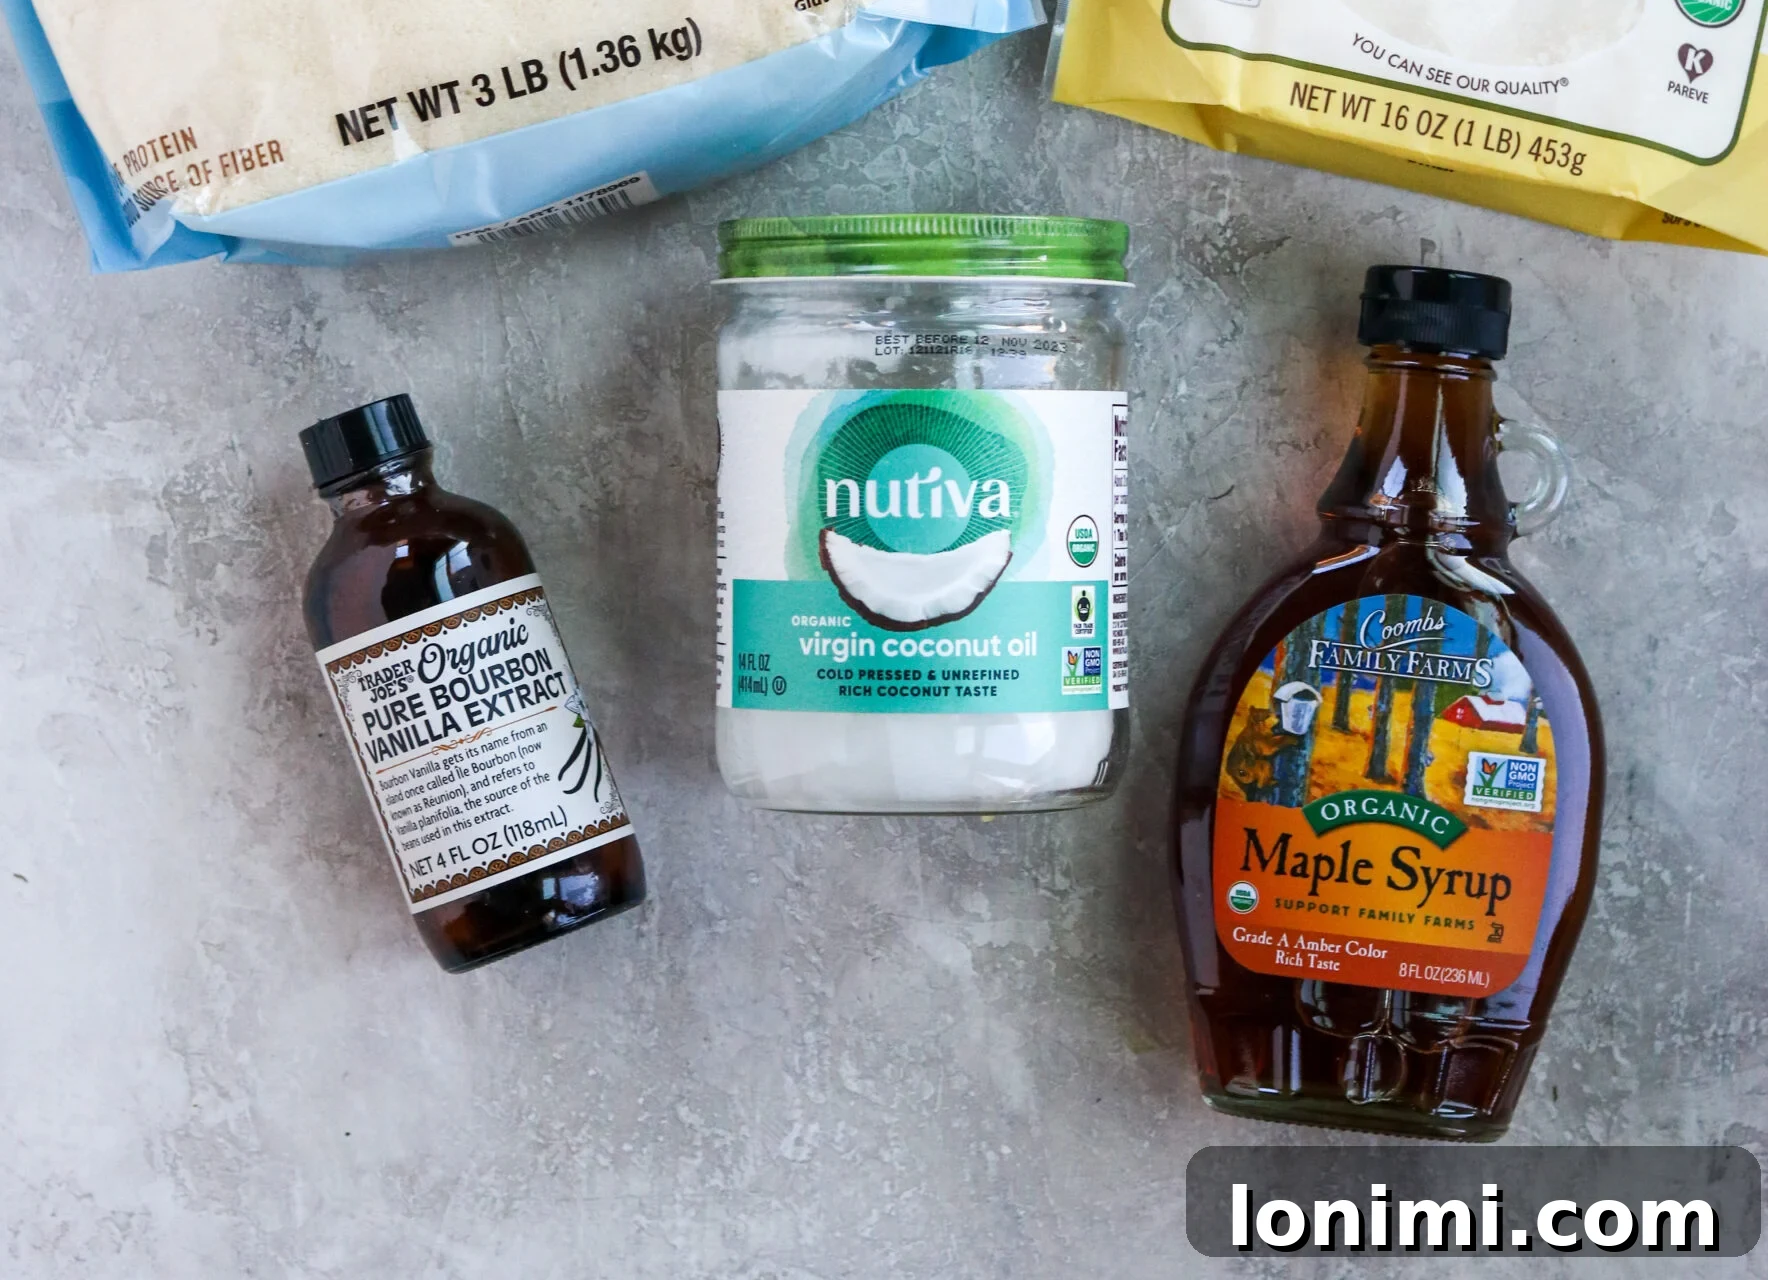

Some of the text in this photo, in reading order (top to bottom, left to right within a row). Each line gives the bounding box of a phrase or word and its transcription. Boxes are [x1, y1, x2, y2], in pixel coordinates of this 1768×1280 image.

[1352, 33, 1385, 60] YOU
[1388, 54, 1423, 76] CAN
[1426, 68, 1452, 85] SEE
[1457, 76, 1490, 93] OUR
[336, 17, 702, 146] NET WT 3 LB (1.36 kg)
[1667, 81, 1708, 104] PAREVE
[1290, 81, 1586, 176] NET WT 16 OZ (1 LB) 453g
[123, 127, 198, 176] PROTEIN
[136, 170, 179, 211] SOURCE
[187, 160, 213, 187] OF
[219, 139, 284, 178] FIBER
[875, 335, 909, 345] BEST
[916, 335, 968, 344] BEFORE
[975, 336, 989, 345] 12
[1002, 338, 1027, 347] NOV
[825, 471, 1011, 519] nutiva
[1075, 528, 1093, 539] USDA
[791, 616, 852, 627] ORGANIC
[1359, 606, 1447, 650] Coombs
[418, 618, 529, 684] Organic
[739, 653, 770, 671] 14 FL OZ
[800, 632, 1037, 662] virgin coconut oil
[1308, 640, 1493, 687] FAMILY FARMS
[358, 659, 416, 692] TRADER
[362, 647, 553, 736] PURE BOURBON
[817, 669, 1019, 681] COLD PRESSED & UNREFINED
[839, 686, 997, 696] RICH COCONUT TASTE
[365, 671, 567, 764] VANILLA EXTRACT
[379, 722, 548, 791] Bourbon Vanilla gets its name from an
[1510, 762, 1537, 772] NON
[1476, 787, 1533, 800] VERIFIED
[1509, 771, 1536, 781] GMO
[1320, 797, 1450, 834] ORGANIC
[409, 805, 567, 878] NET 4 FL OZ (118mL)
[1240, 828, 1512, 916] Maple Syrup
[1275, 898, 1475, 930] SUPPORT FAMILY FARMS
[1233, 927, 1388, 959] Grade A Amber Color
[1276, 950, 1340, 971] Rich Taste
